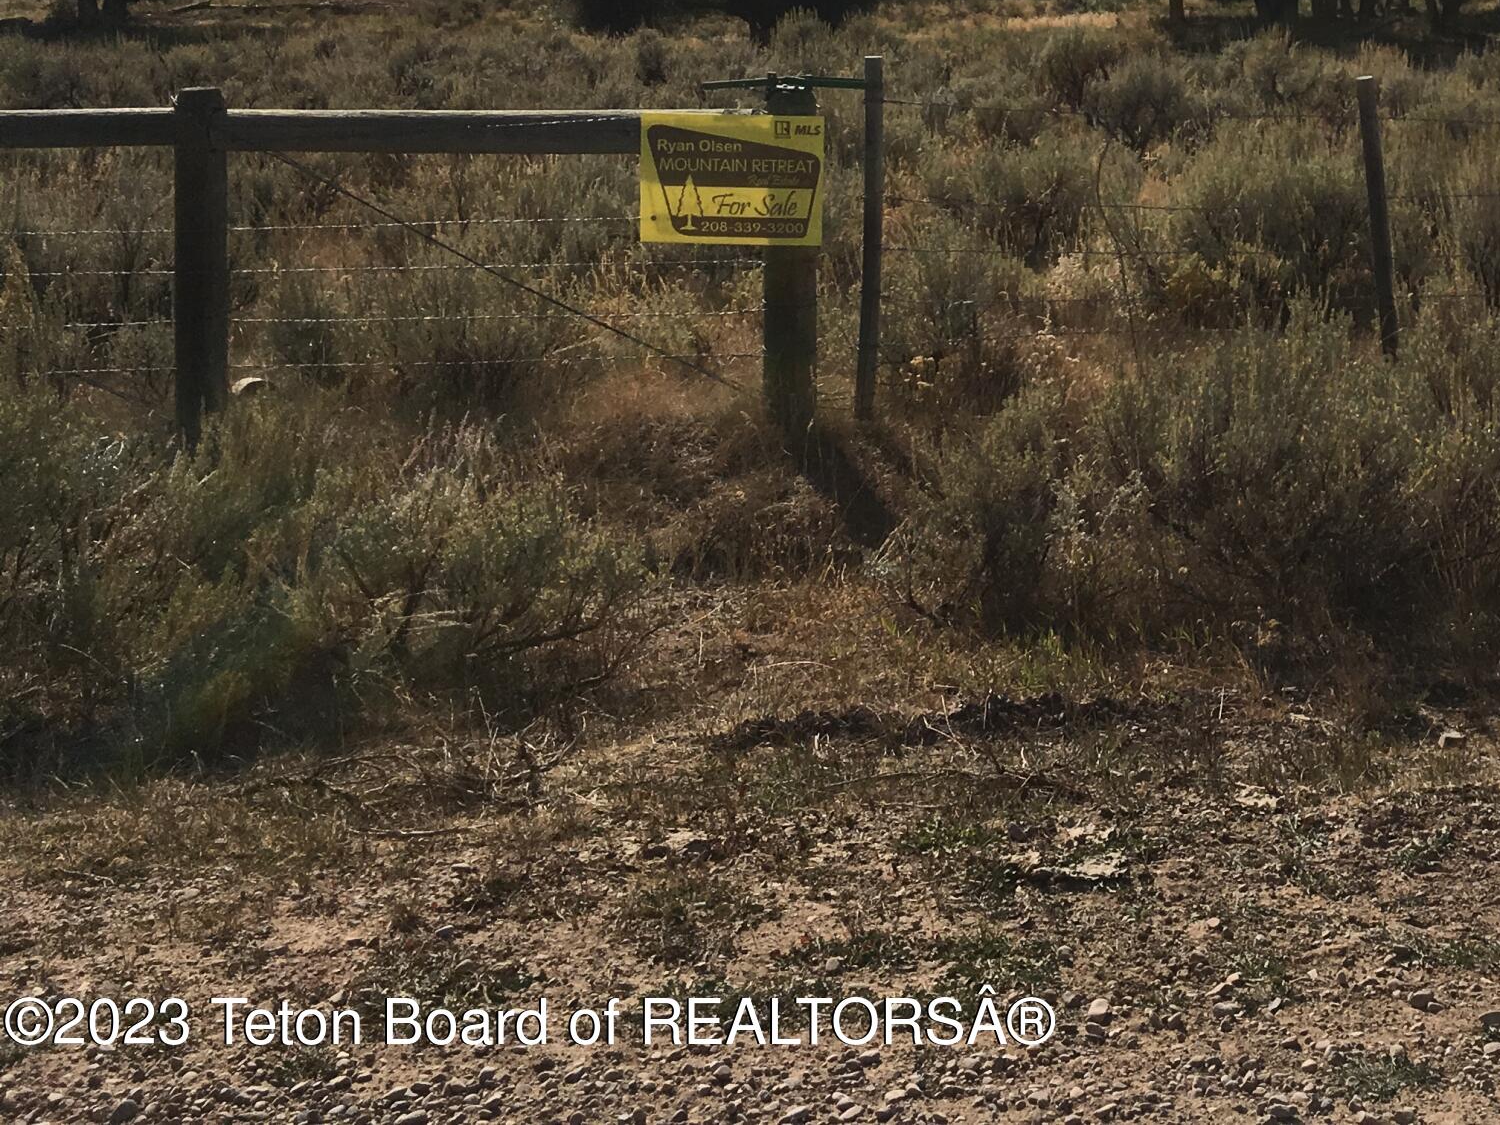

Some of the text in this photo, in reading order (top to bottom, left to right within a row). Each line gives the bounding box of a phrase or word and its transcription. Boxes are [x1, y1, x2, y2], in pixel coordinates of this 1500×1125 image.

[794, 125, 821, 135] MLS
[657, 139, 742, 154] Ryan Olsen
[659, 158, 815, 173] MOUNTAIN RETREAT
[712, 191, 797, 216] For Sale
[701, 222, 804, 233] 208-339-3200
